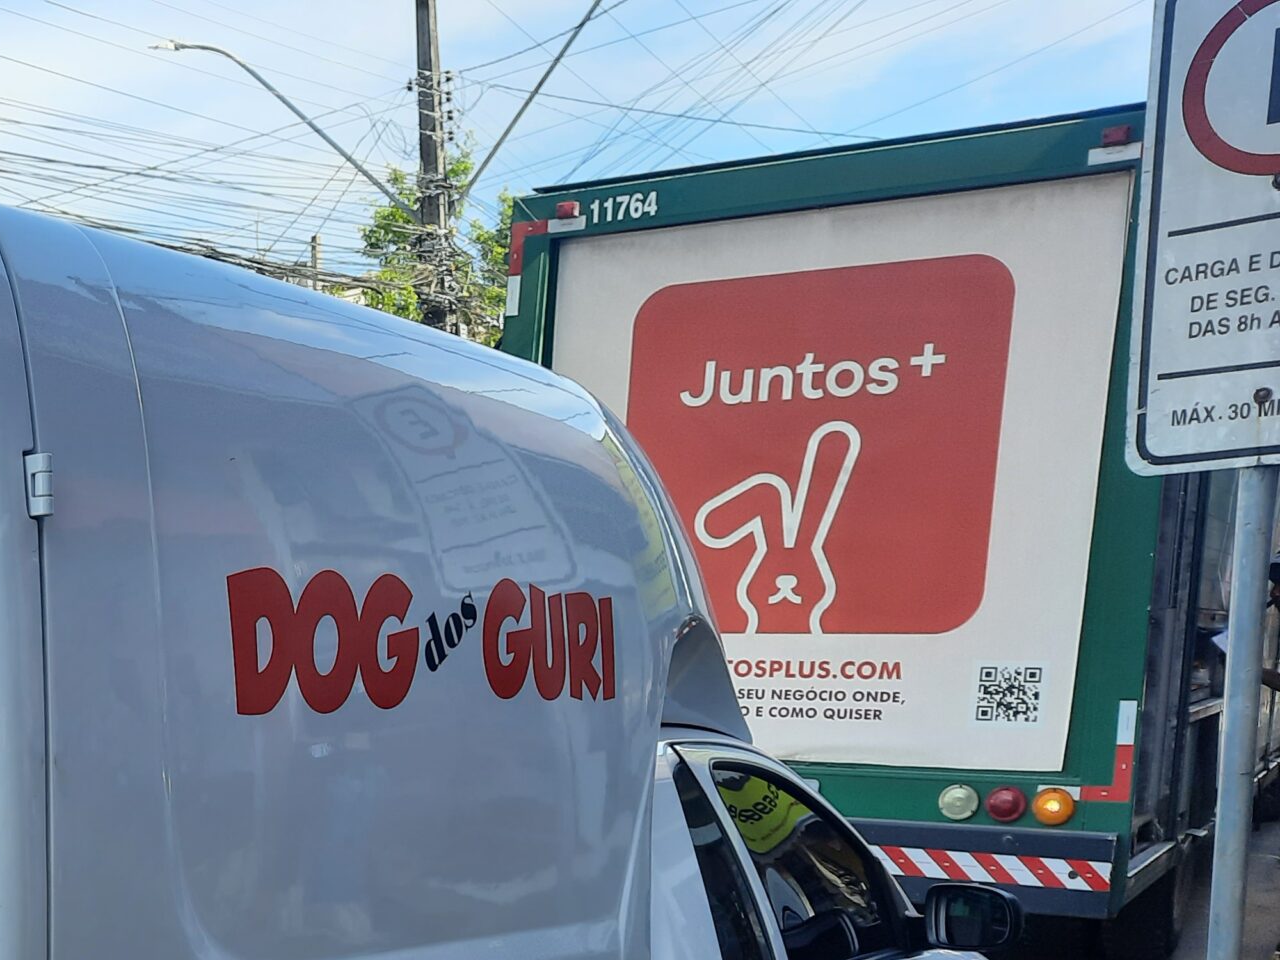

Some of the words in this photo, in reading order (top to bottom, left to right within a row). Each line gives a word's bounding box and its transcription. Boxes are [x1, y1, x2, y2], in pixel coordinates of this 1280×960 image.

[590, 190, 658, 224] 11764
[1164, 257, 1240, 285] CARGA
[1248, 253, 1262, 272] E
[1190, 292, 1219, 313] DE
[1225, 285, 1275, 308] SEG.
[1188, 317, 1231, 339] DAS
[1237, 313, 1262, 332] 8h
[1171, 401, 1223, 427] MÁX.
[1228, 402, 1251, 421] 30
[226, 567, 419, 715] DOG
[424, 591, 477, 672] dos
[482, 578, 616, 701] GURI
[728, 659, 902, 680] OSPLUS.COM
[737, 688, 765, 700] SEU
[771, 687, 847, 703] NEGÓCIO
[852, 691, 906, 705] ONDE,
[756, 707, 764, 717] E
[769, 706, 818, 719] COMO
[823, 708, 883, 721] QUISER
